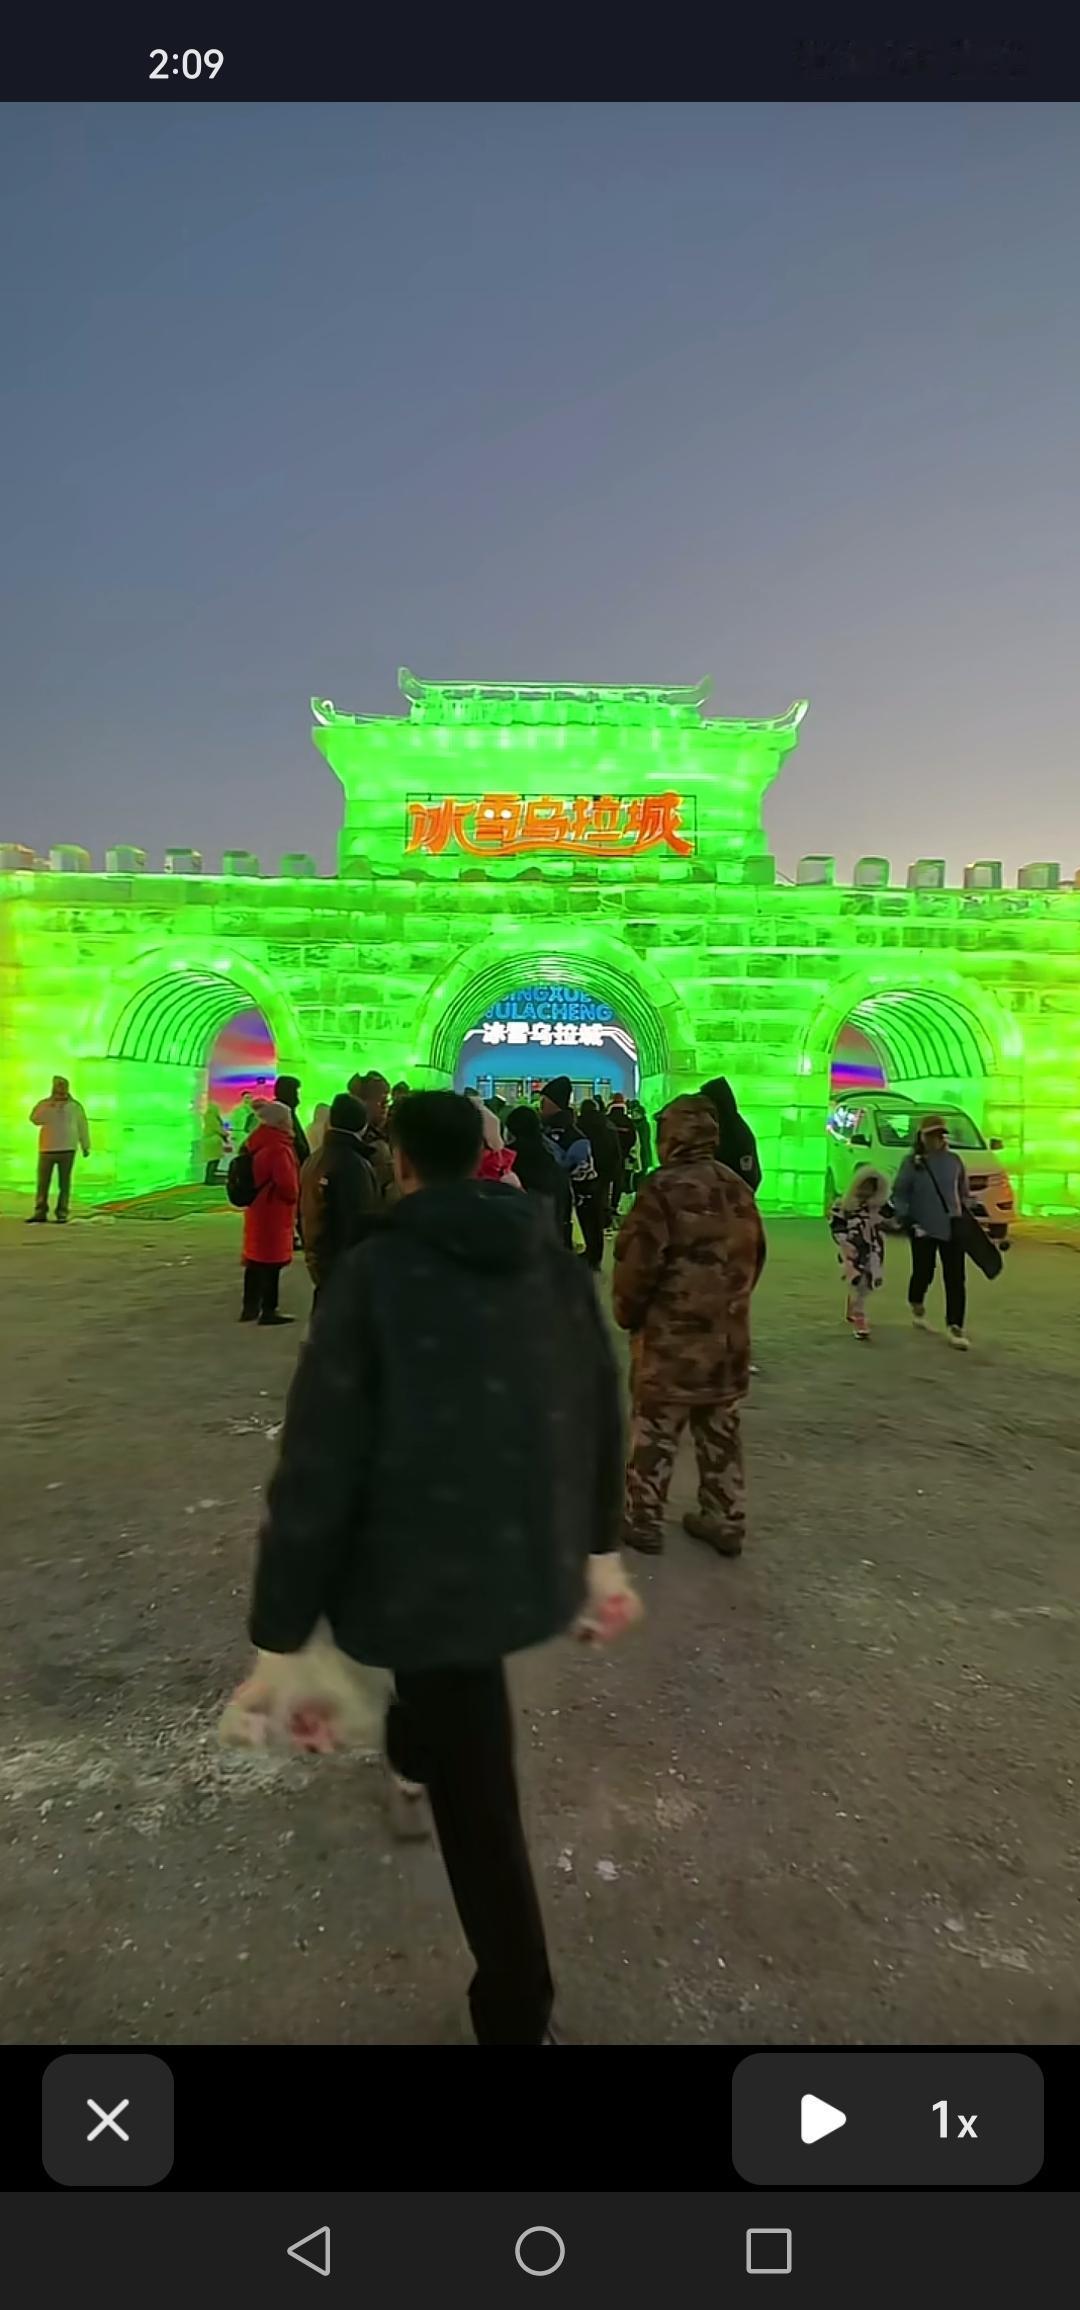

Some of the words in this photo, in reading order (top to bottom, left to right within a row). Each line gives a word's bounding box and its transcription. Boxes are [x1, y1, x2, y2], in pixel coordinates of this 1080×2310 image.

[404, 791, 694, 856] 冰雪乌拉城
[501, 985, 593, 1002] INGXUE
[482, 1021, 604, 1046] 冰雪乌拉城
